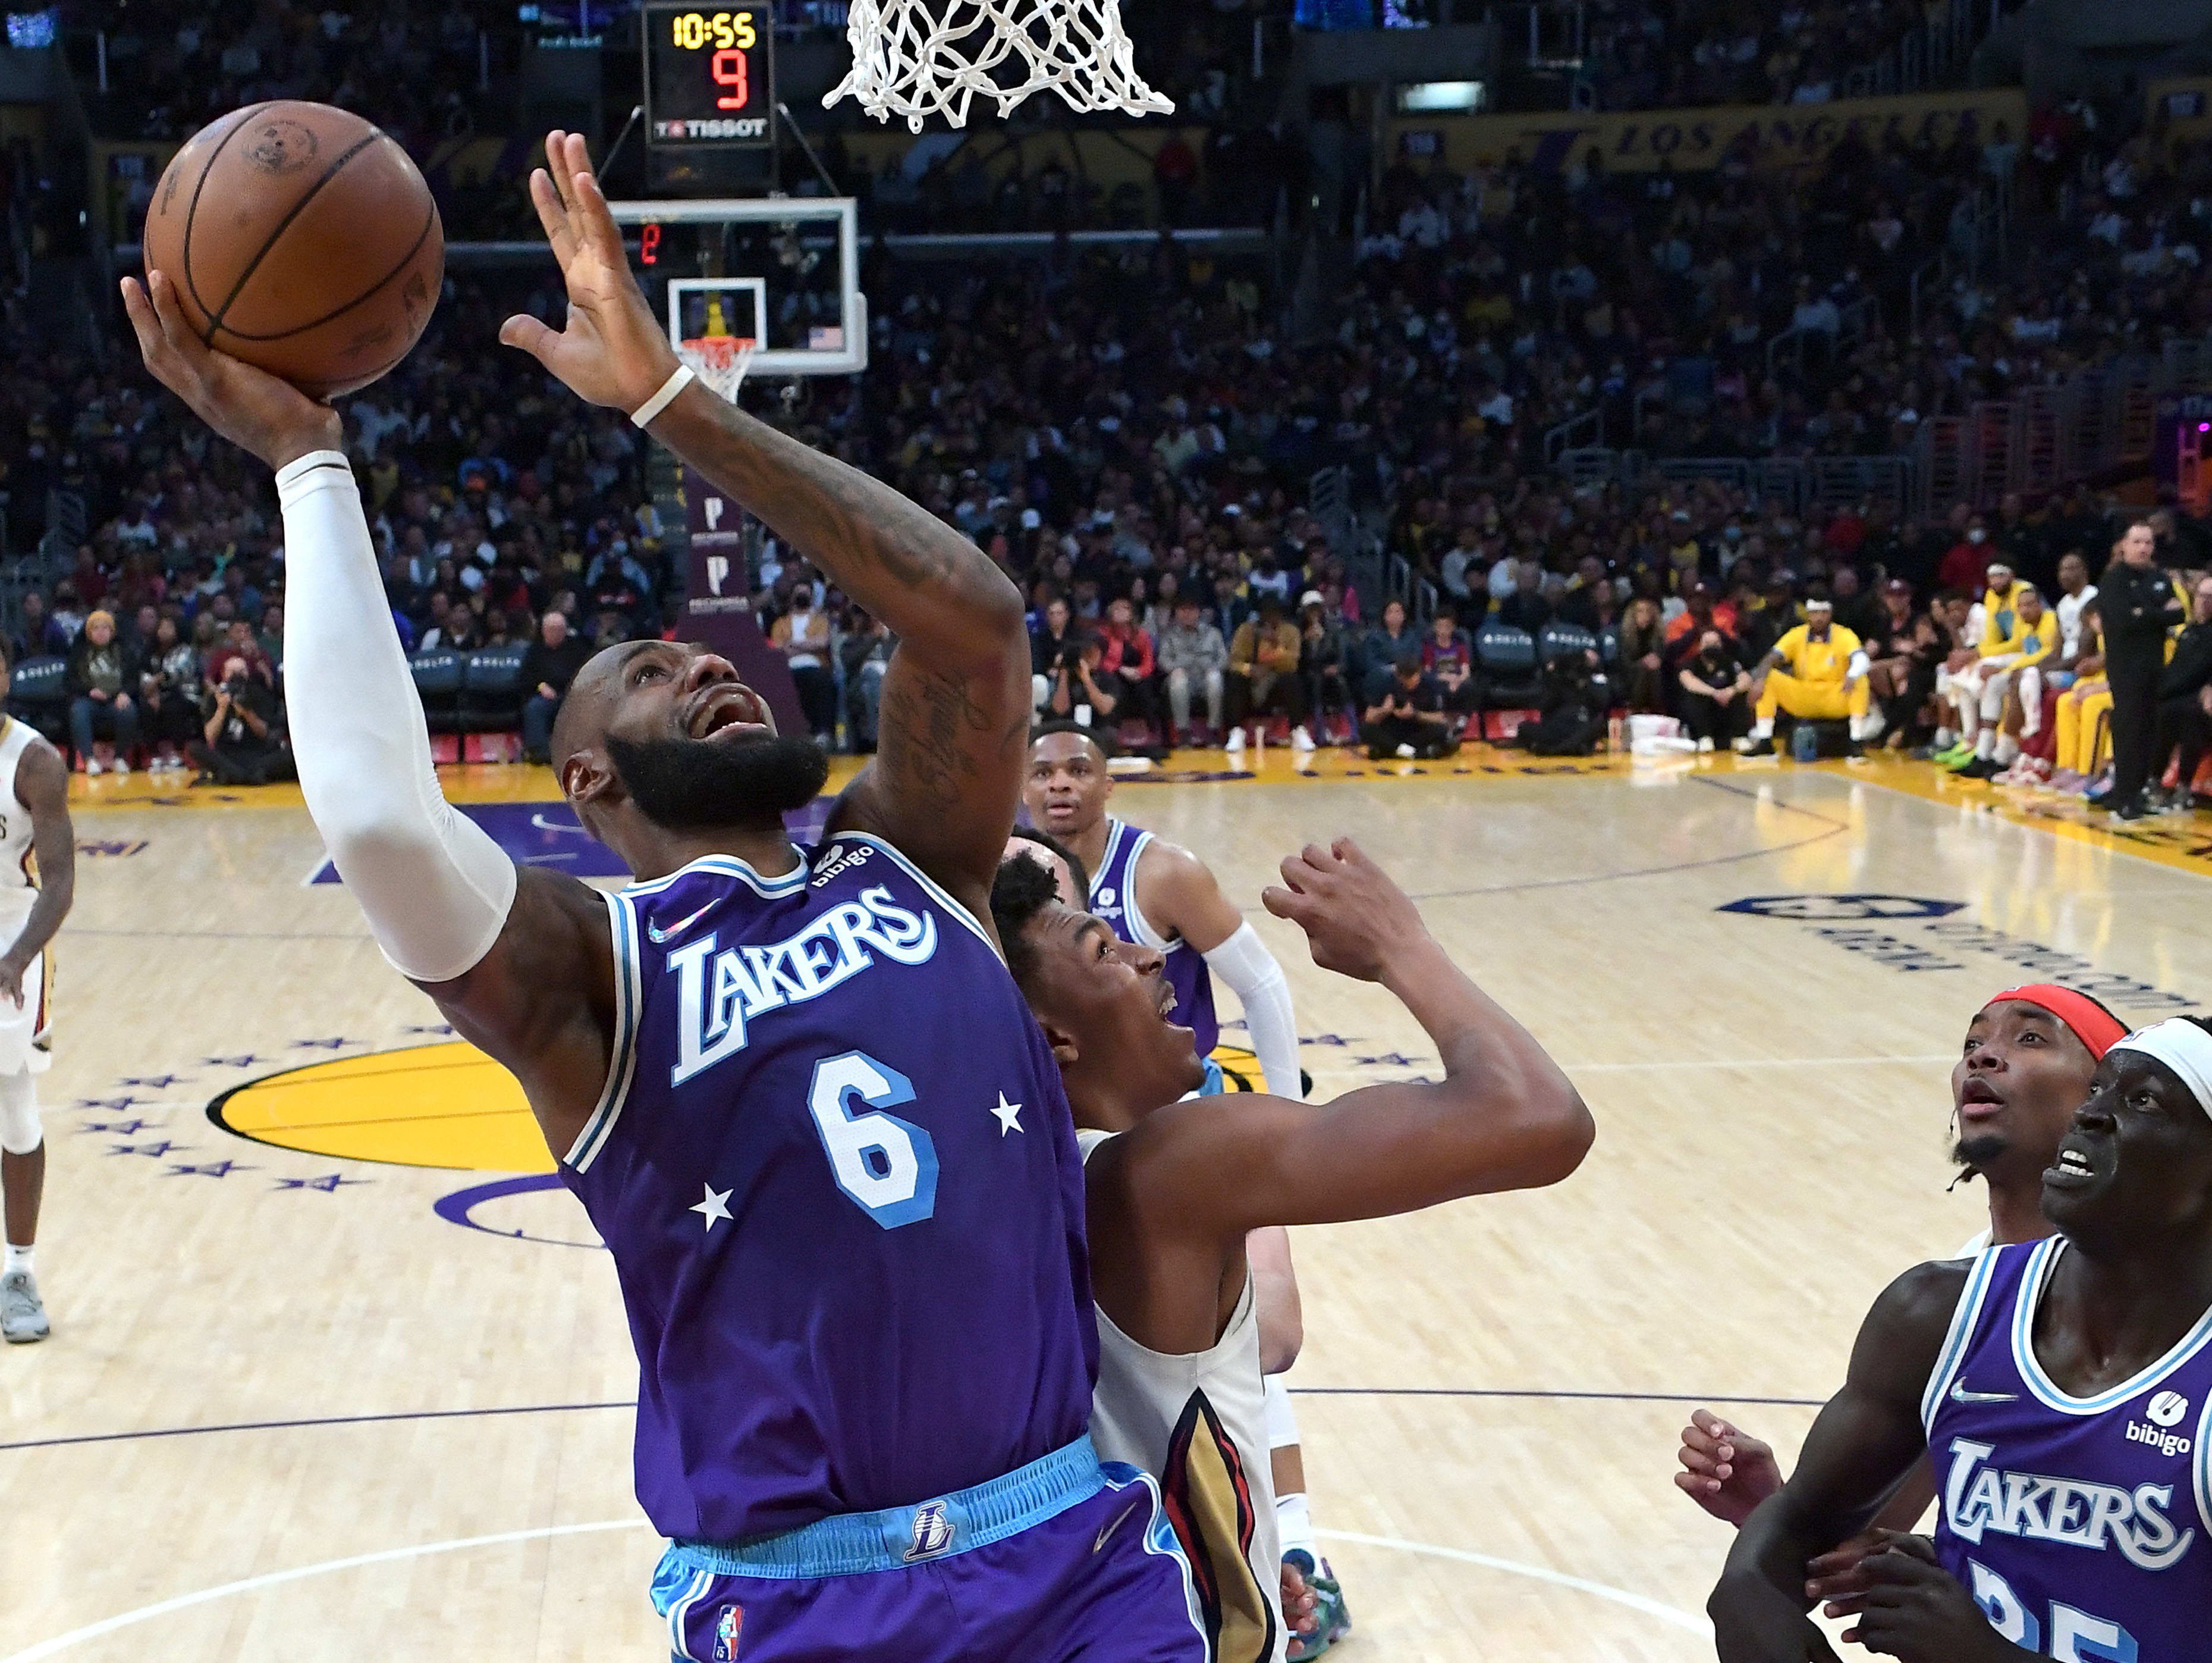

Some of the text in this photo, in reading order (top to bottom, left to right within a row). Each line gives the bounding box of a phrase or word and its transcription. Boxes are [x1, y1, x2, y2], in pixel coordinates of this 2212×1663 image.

[673, 12, 756, 50] 10:55
[712, 49, 747, 109] 9
[686, 118, 767, 137] TISSOT
[1615, 121, 1714, 156] LOS
[811, 846, 875, 888] bibigo
[666, 883, 938, 1089] LAKERS
[806, 1049, 940, 1231] 6
[2125, 1419, 2191, 1457] bibigo
[1945, 1436, 2196, 1571] LAKERS
